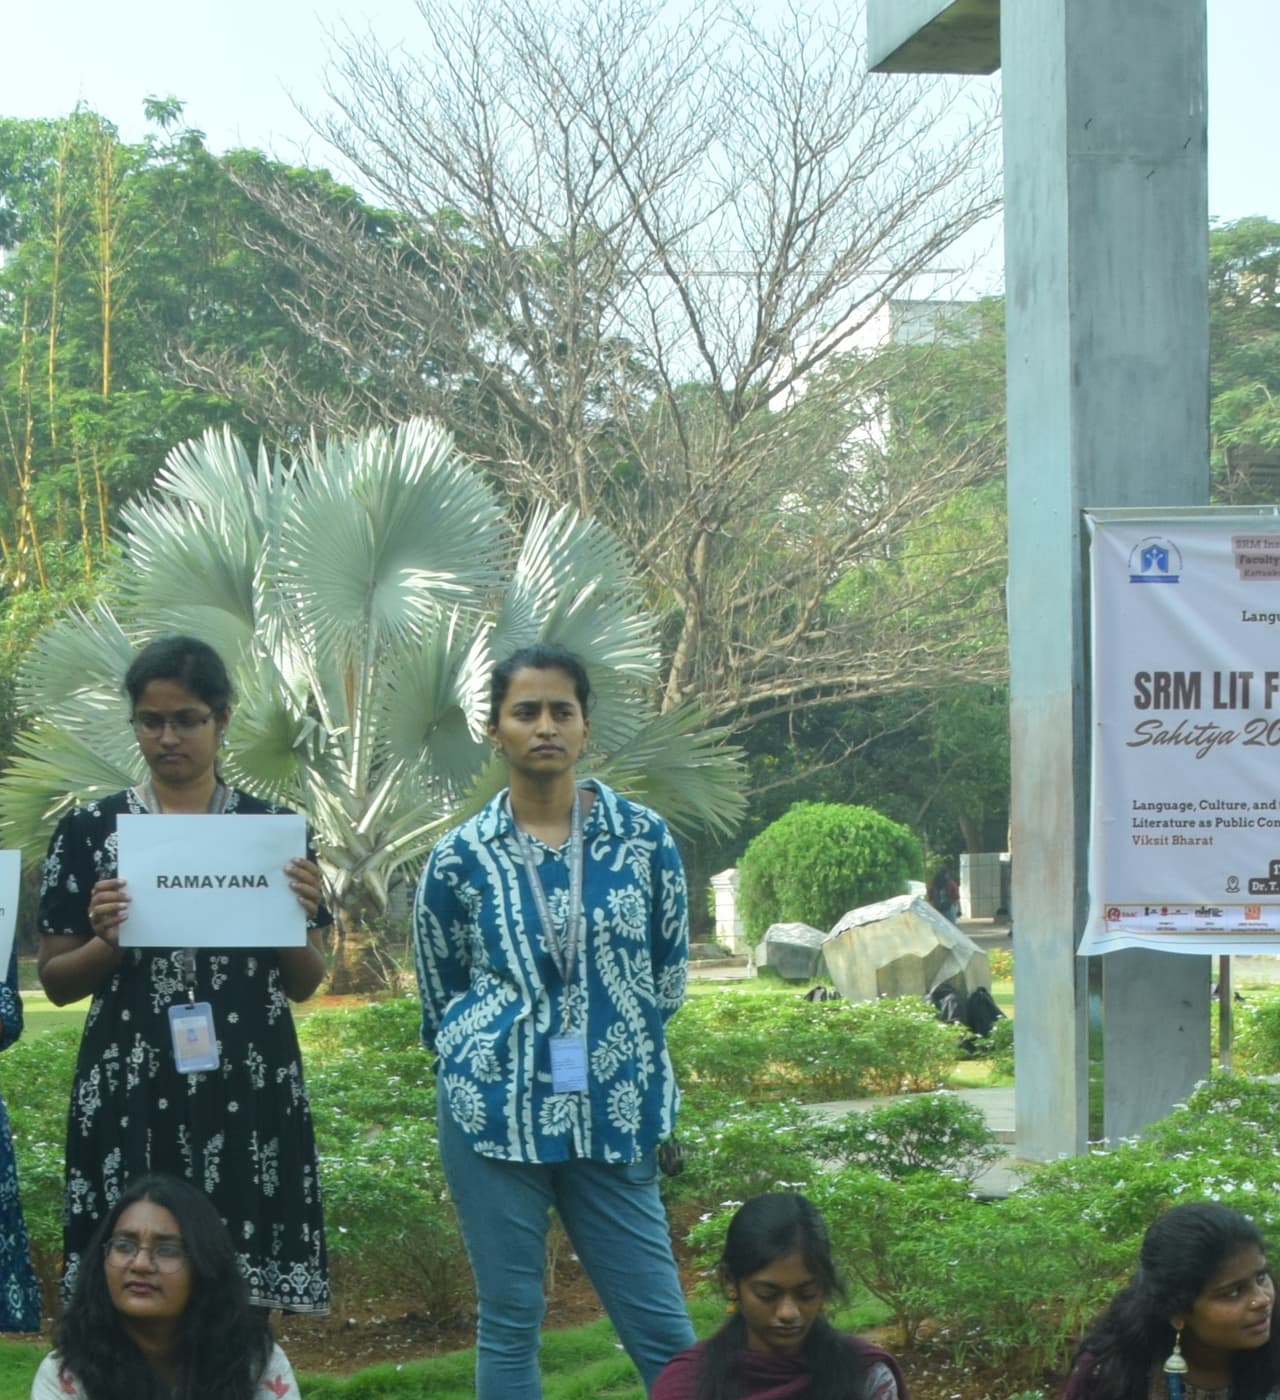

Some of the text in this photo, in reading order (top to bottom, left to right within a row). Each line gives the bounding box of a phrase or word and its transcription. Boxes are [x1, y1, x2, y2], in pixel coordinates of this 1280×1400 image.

[1240, 553, 1279, 567] Faculty
[1133, 671, 1201, 710] SRM
[1213, 671, 1254, 710] LIT
[1125, 718, 1240, 760] Sahitya
[1132, 800, 1197, 813] Language,
[1199, 800, 1251, 812] Culture,
[1253, 800, 1277, 811] and
[1132, 817, 1196, 828] Literature
[1198, 820, 1212, 828] as
[1215, 817, 1255, 828] Public
[1132, 835, 1214, 846] Viksit Bharat
[156, 875, 269, 888] RAMAYANA
[1251, 882, 1267, 891] Dr.
[1269, 882, 1278, 891] T.
